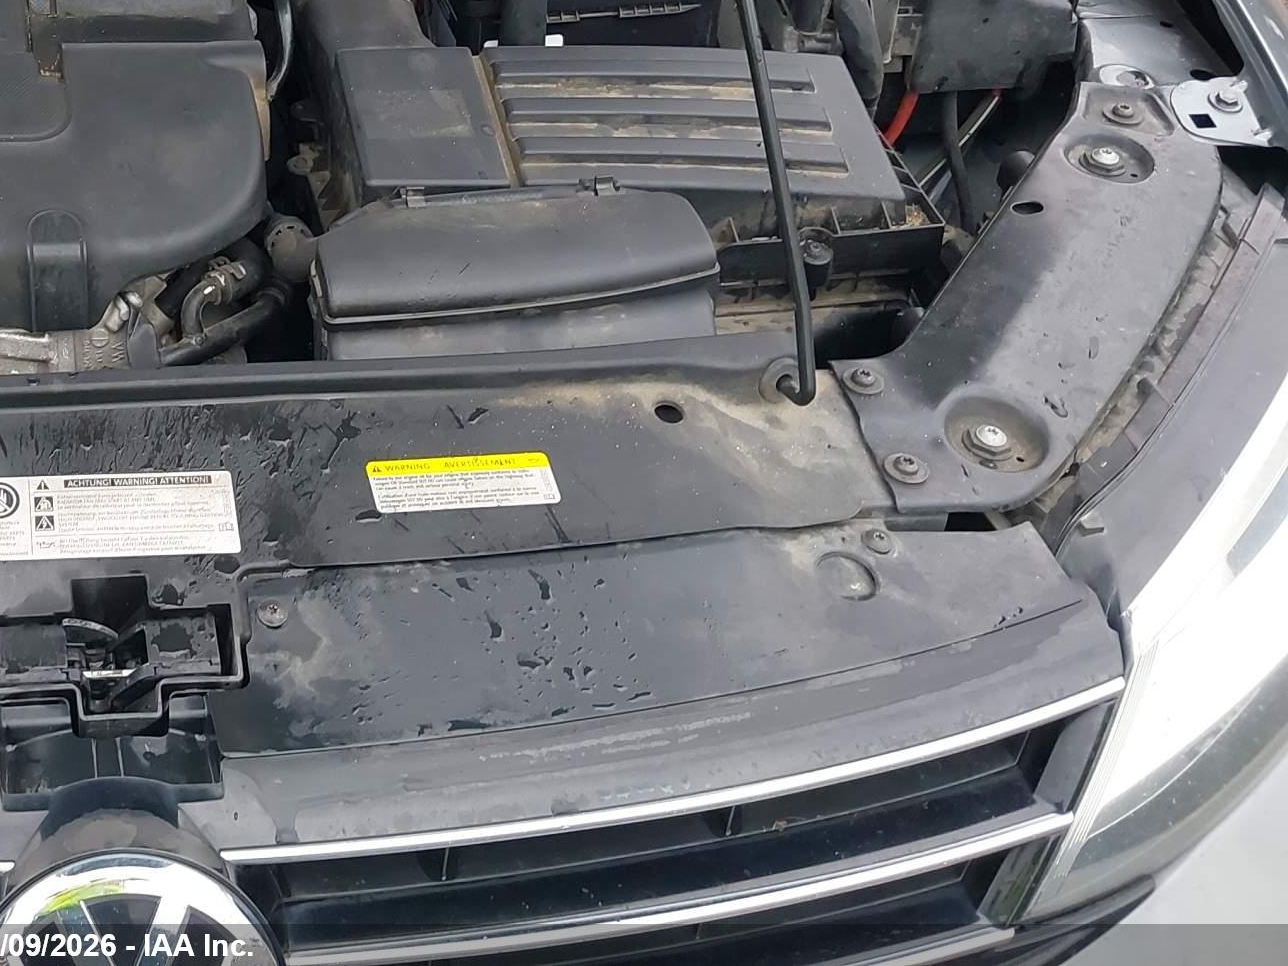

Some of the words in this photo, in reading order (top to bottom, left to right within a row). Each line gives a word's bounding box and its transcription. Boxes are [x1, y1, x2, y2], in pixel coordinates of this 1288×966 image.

[67, 479, 112, 487] ACHTUNG!
[114, 477, 158, 486] WARNING!
[160, 475, 210, 484] ATTENTION!
